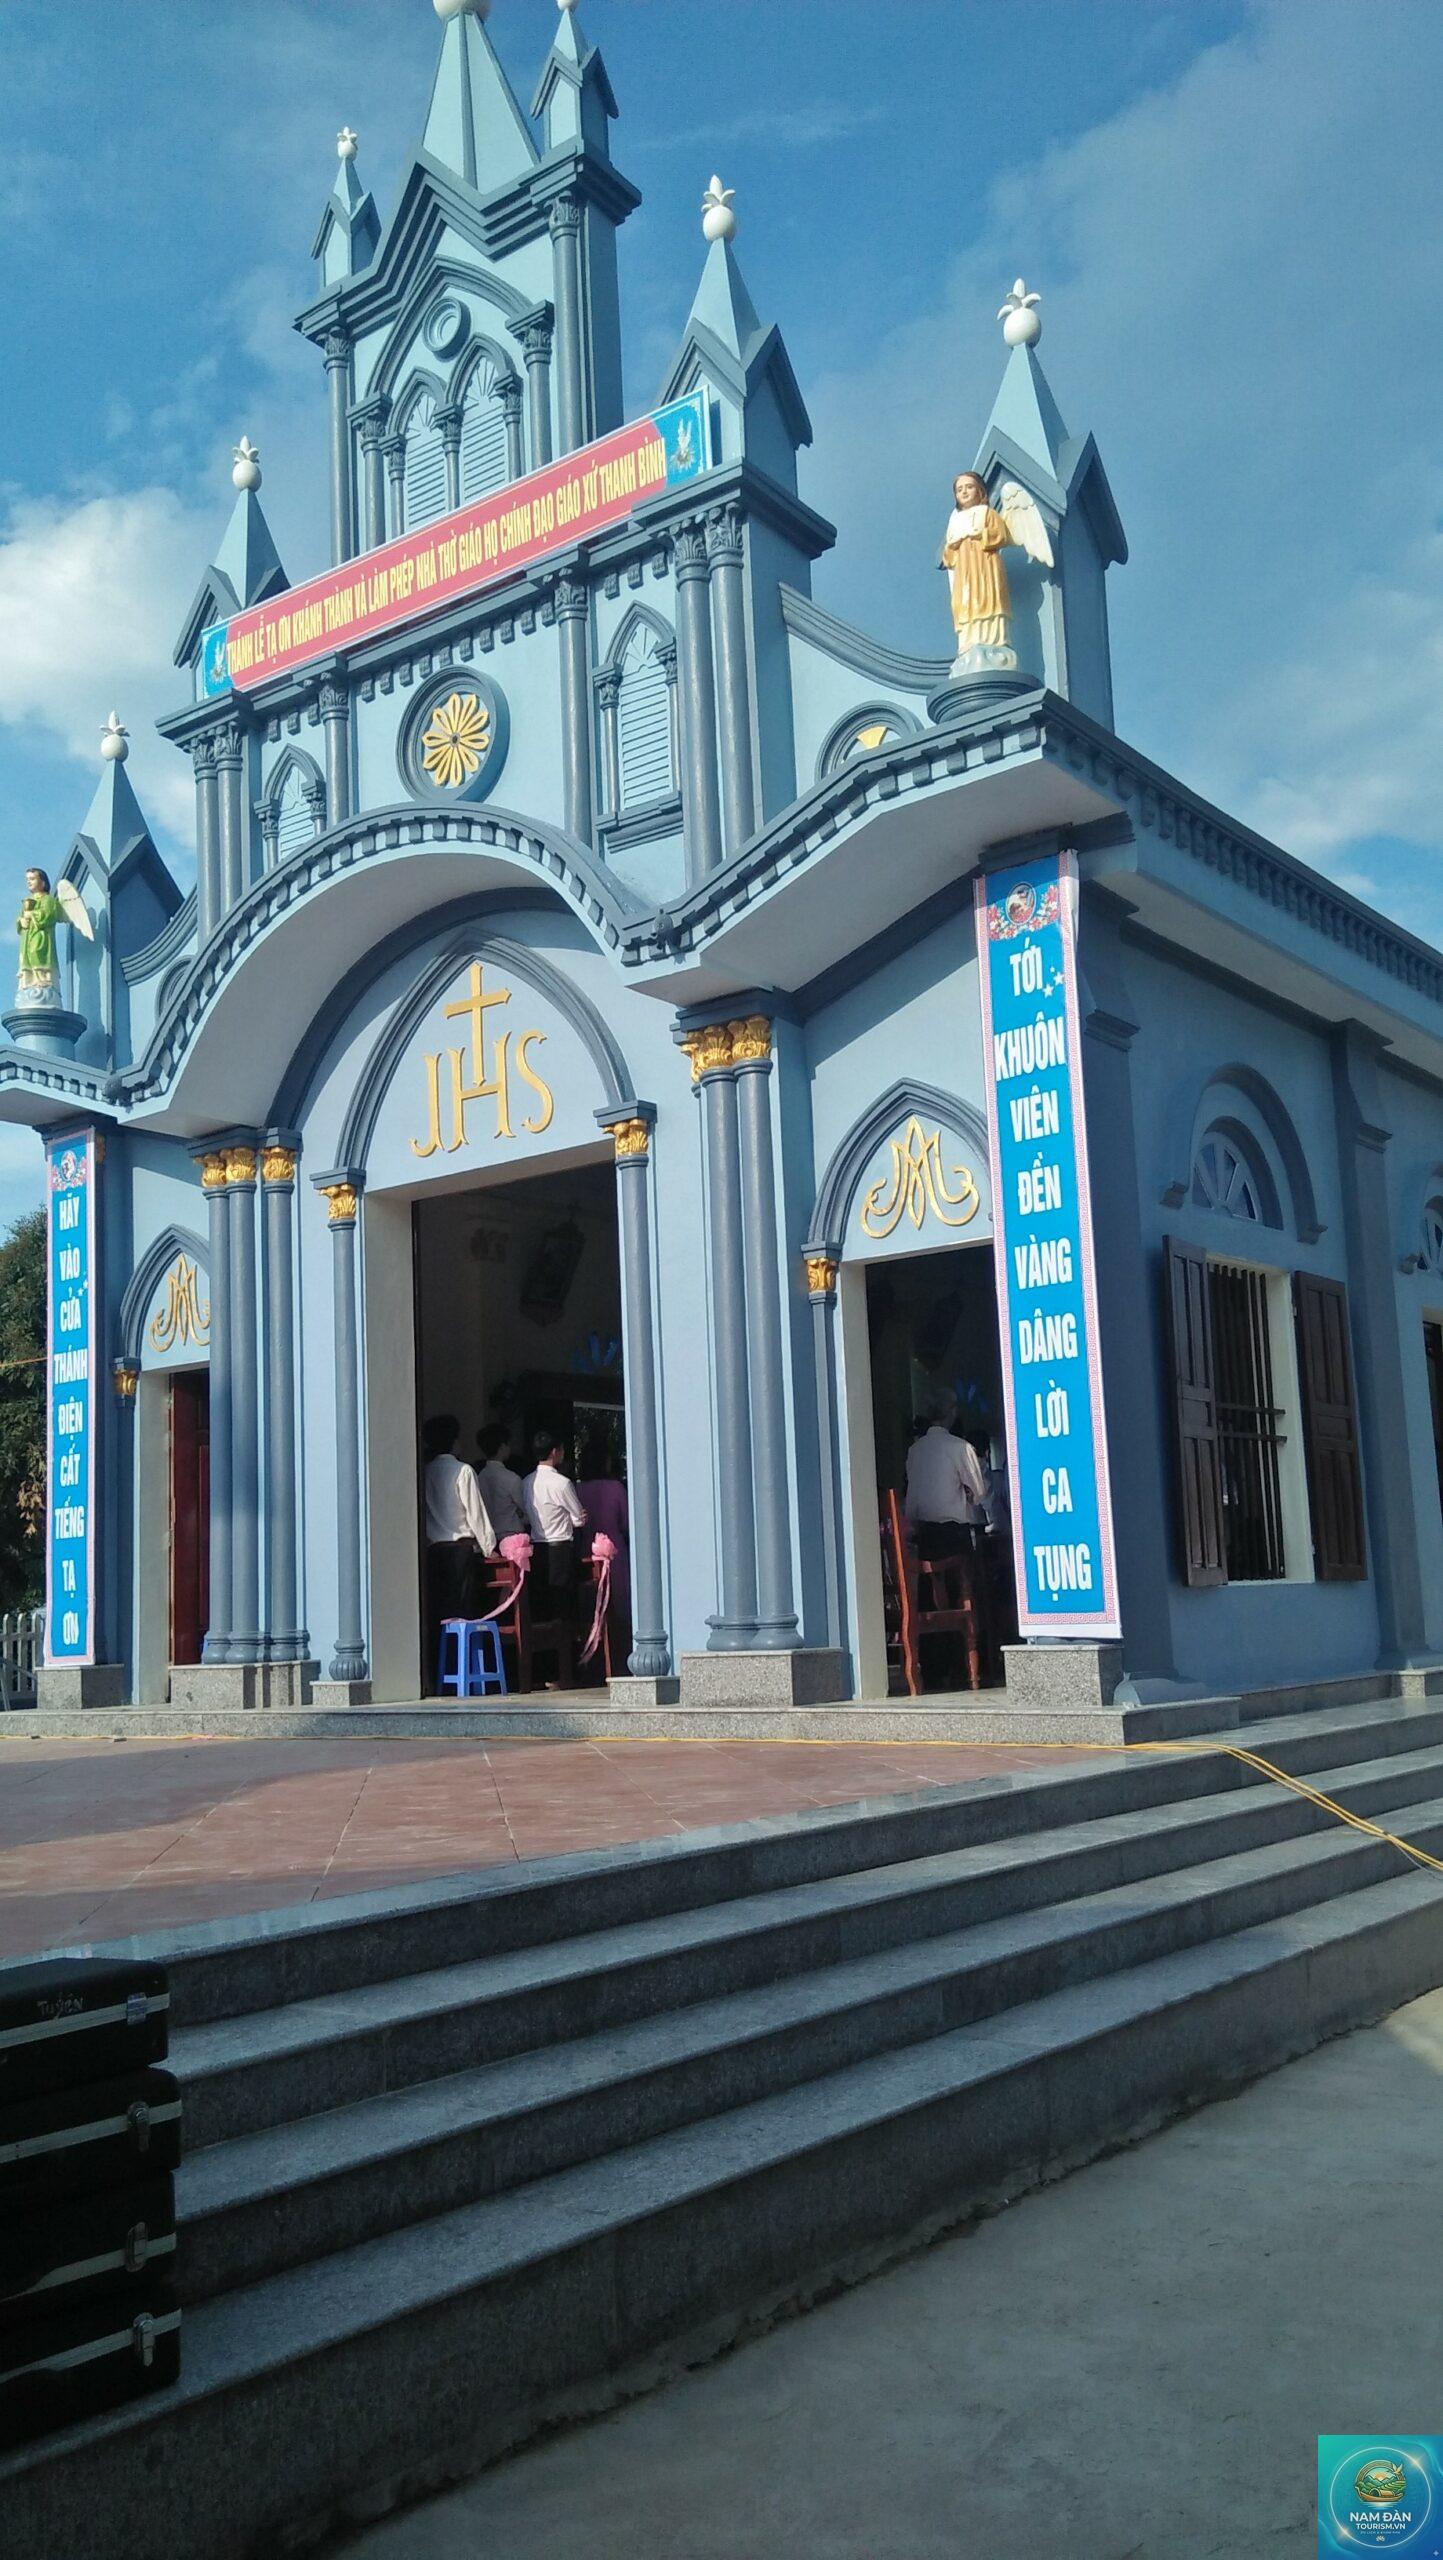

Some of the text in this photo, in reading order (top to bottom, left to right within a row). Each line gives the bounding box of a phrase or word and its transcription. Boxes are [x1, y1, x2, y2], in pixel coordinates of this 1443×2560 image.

[227, 437, 666, 675] THÁNH LỄ TẠ ƠN KHÁNH THÀNH VÀ LÀM PHÉP NHÀ THỜ GIÁO HỌ CHÍNH ĐẠO GIÁO XỨ THANH BÌNH
[1010, 937, 1043, 997] TỚI
[994, 1011, 1066, 1081] KHUÔN
[1010, 1084, 1060, 1142] VIÊN
[1017, 1152, 1062, 1216] ĐỀN
[60, 1193, 80, 1231] HÃY
[60, 1243, 80, 1282] VÀO
[1014, 1234, 1072, 1290] VÀNG
[60, 1286, 81, 1332] CỬA
[1018, 1311, 1078, 1364] DÂNG
[54, 1344, 88, 1384] THÁNH
[58, 1396, 83, 1440] ĐIỆN
[1034, 1380, 1070, 1438] LỜI
[60, 1443, 80, 1487] CẤT
[1042, 1467, 1073, 1514] CA
[55, 1496, 84, 1539] TIẾNG
[62, 1560, 76, 1598] TẠ
[1033, 1543, 1092, 1602] TỤNG
[62, 1610, 79, 1645] ƠN
